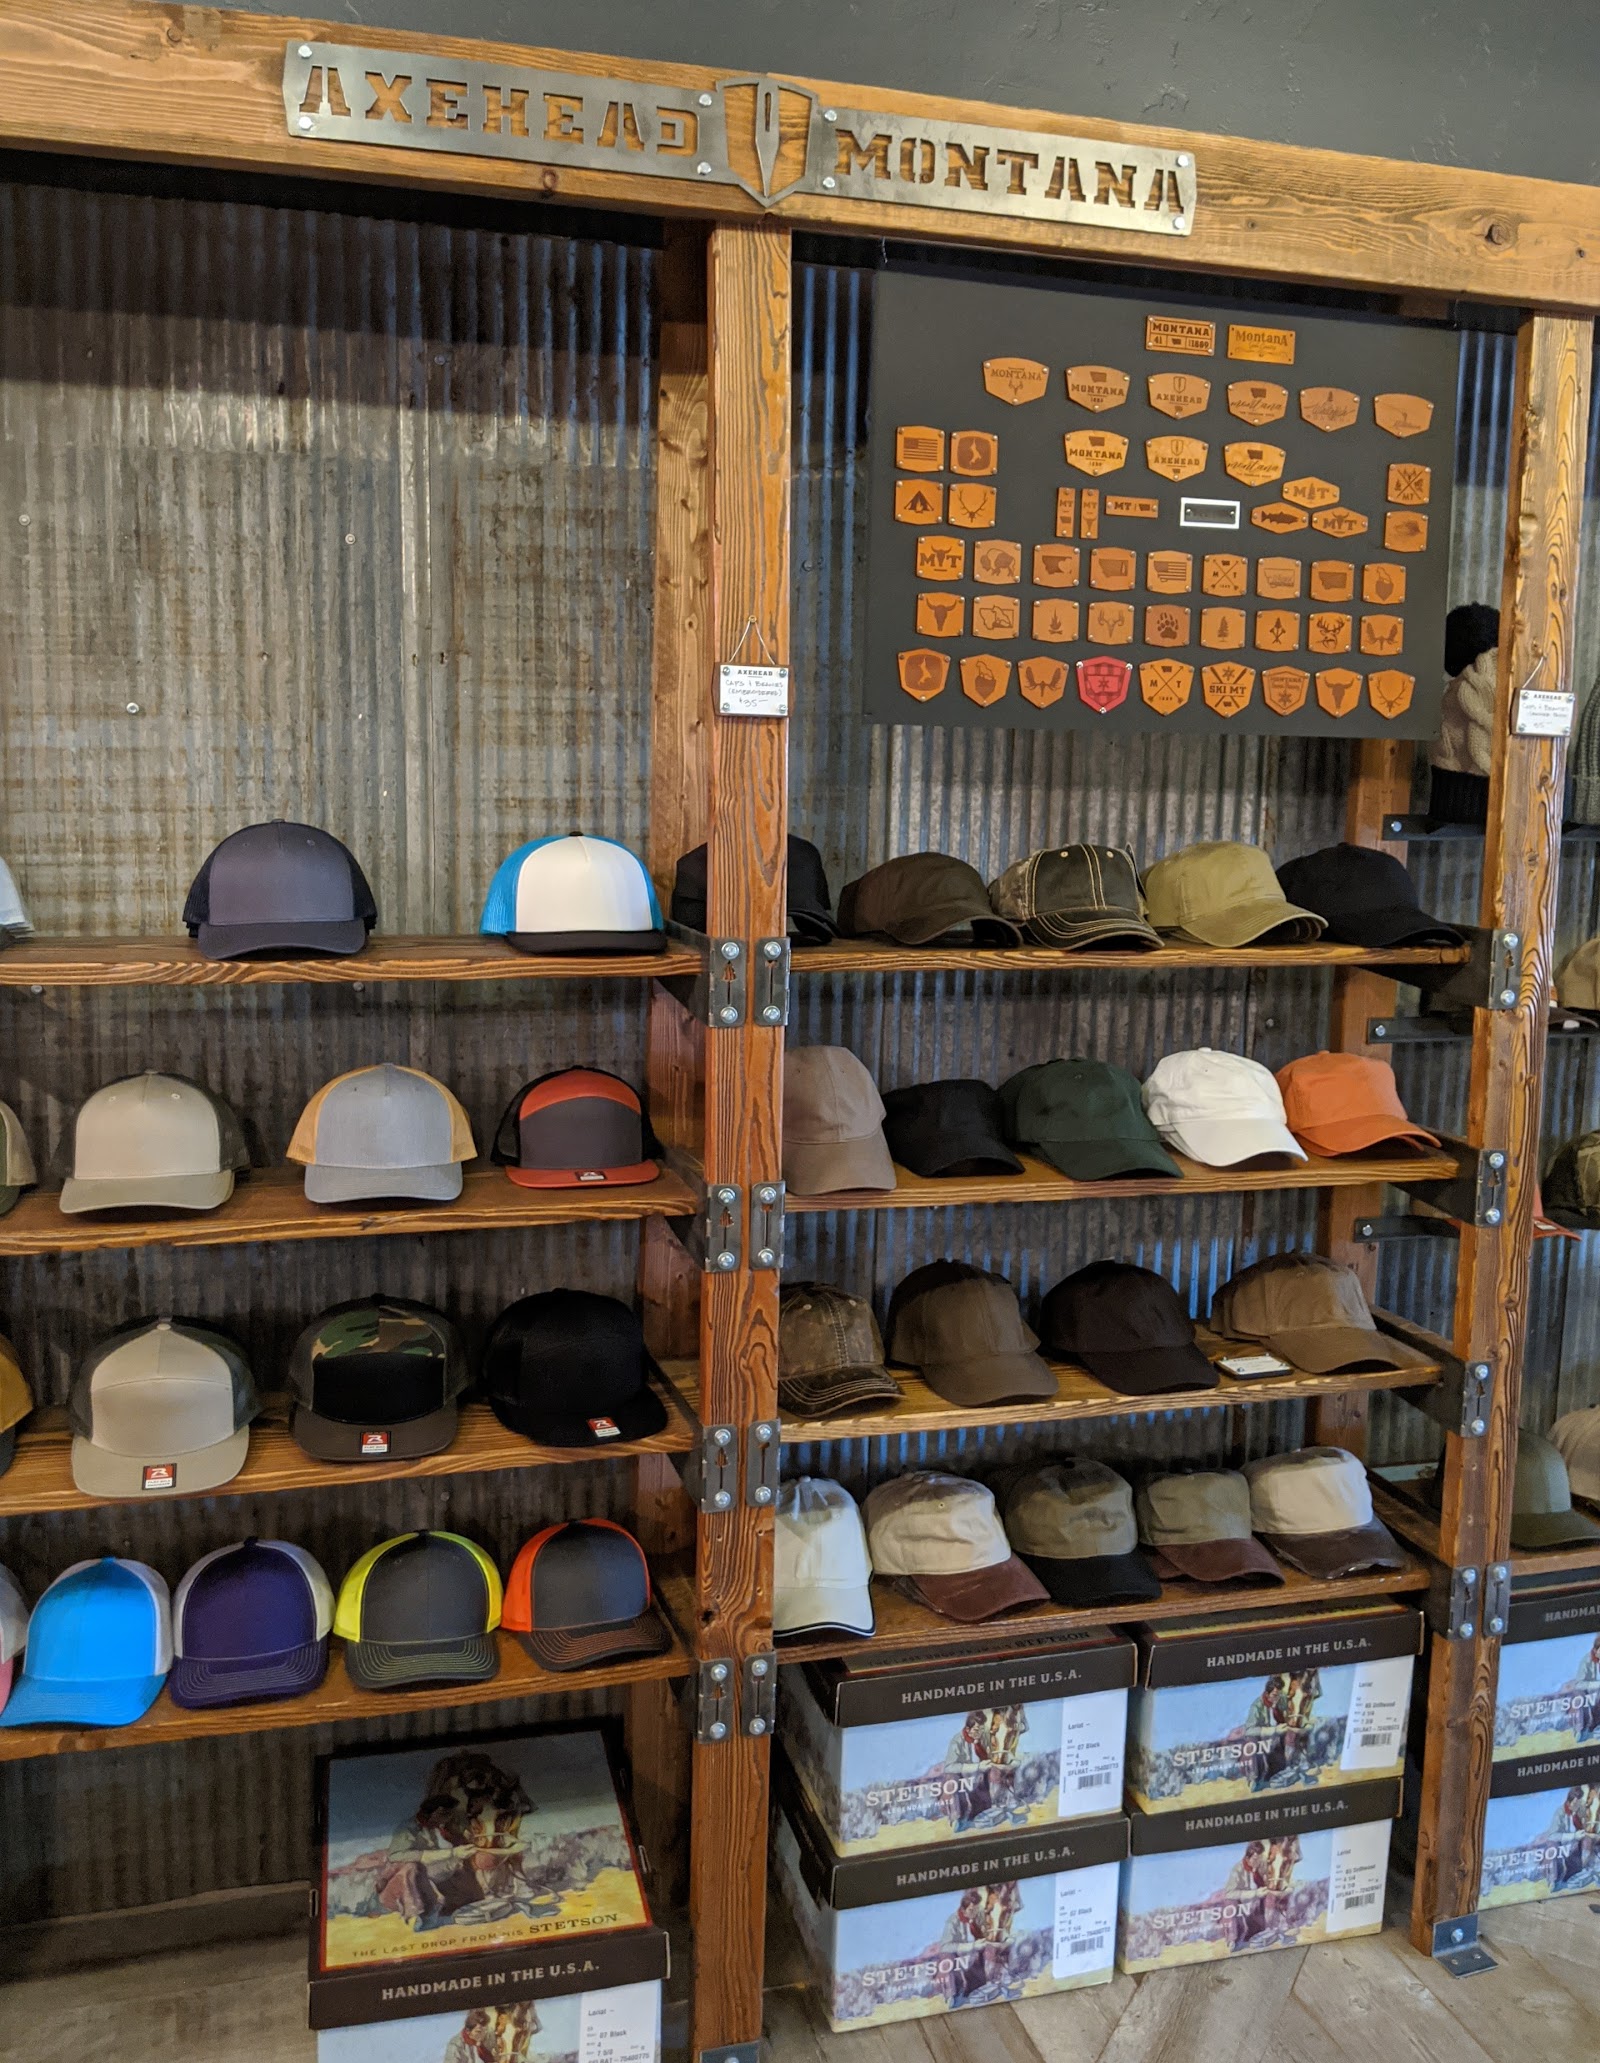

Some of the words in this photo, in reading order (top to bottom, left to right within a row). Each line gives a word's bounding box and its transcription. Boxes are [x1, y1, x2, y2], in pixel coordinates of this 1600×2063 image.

[299, 65, 699, 156] AXEHEAD
[834, 128, 1185, 214] MONTANA
[1153, 322, 1210, 337] MONTANA
[1154, 336, 1163, 345] 41
[990, 367, 1042, 381] MONTANA
[1071, 383, 1125, 397] MONTANA
[1156, 393, 1203, 404] AXEHEAD
[1069, 448, 1123, 460] MONTANA
[1154, 456, 1200, 466] AXEHEAD
[1059, 499, 1073, 508] MT
[1083, 501, 1097, 509] MT
[1114, 502, 1132, 511] MT
[1209, 685, 1227, 694] SKI
[1229, 686, 1247, 695] MT
[1206, 1648, 1283, 1668] HANDMADE
[1286, 1646, 1301, 1658] IN
[1305, 1642, 1330, 1655] THE
[1333, 1637, 1372, 1651] U.S.A.
[901, 1682, 985, 1703] HANDMADE
[989, 1679, 1005, 1691] IN
[1009, 1674, 1036, 1688] THE
[1040, 1668, 1082, 1684] U.S.A.
[1509, 1693, 1598, 1718] STETSON
[1173, 1738, 1273, 1767] STETSON
[1517, 1757, 1584, 1777] HANDMADE
[1587, 1754, 1600, 1766] IN
[866, 1777, 976, 1807] STETSON
[1185, 1811, 1261, 1831] HANDMADE
[1265, 1809, 1280, 1821] IN
[1283, 1804, 1308, 1818] THE
[1311, 1799, 1350, 1814] U.S.A.
[896, 1862, 980, 1886] HANDMADE
[983, 1858, 999, 1871] IN
[1003, 1853, 1031, 1868] THE
[1034, 1846, 1076, 1863] U.S.A.
[1483, 1844, 1573, 1870] STETSON
[1152, 1901, 1253, 1929] STETSON
[352, 1948, 377, 1958] THE
[383, 1943, 416, 1953] LAST
[421, 1937, 457, 1950] DROP
[462, 1933, 497, 1944] FROM
[529, 1913, 619, 1935] STETSON
[381, 1976, 482, 2000] HANDMADE
[487, 1971, 506, 1986] IN
[511, 1966, 545, 1983] THE
[549, 1959, 600, 1978] U.S.A.
[861, 1955, 971, 1987] STETSON
